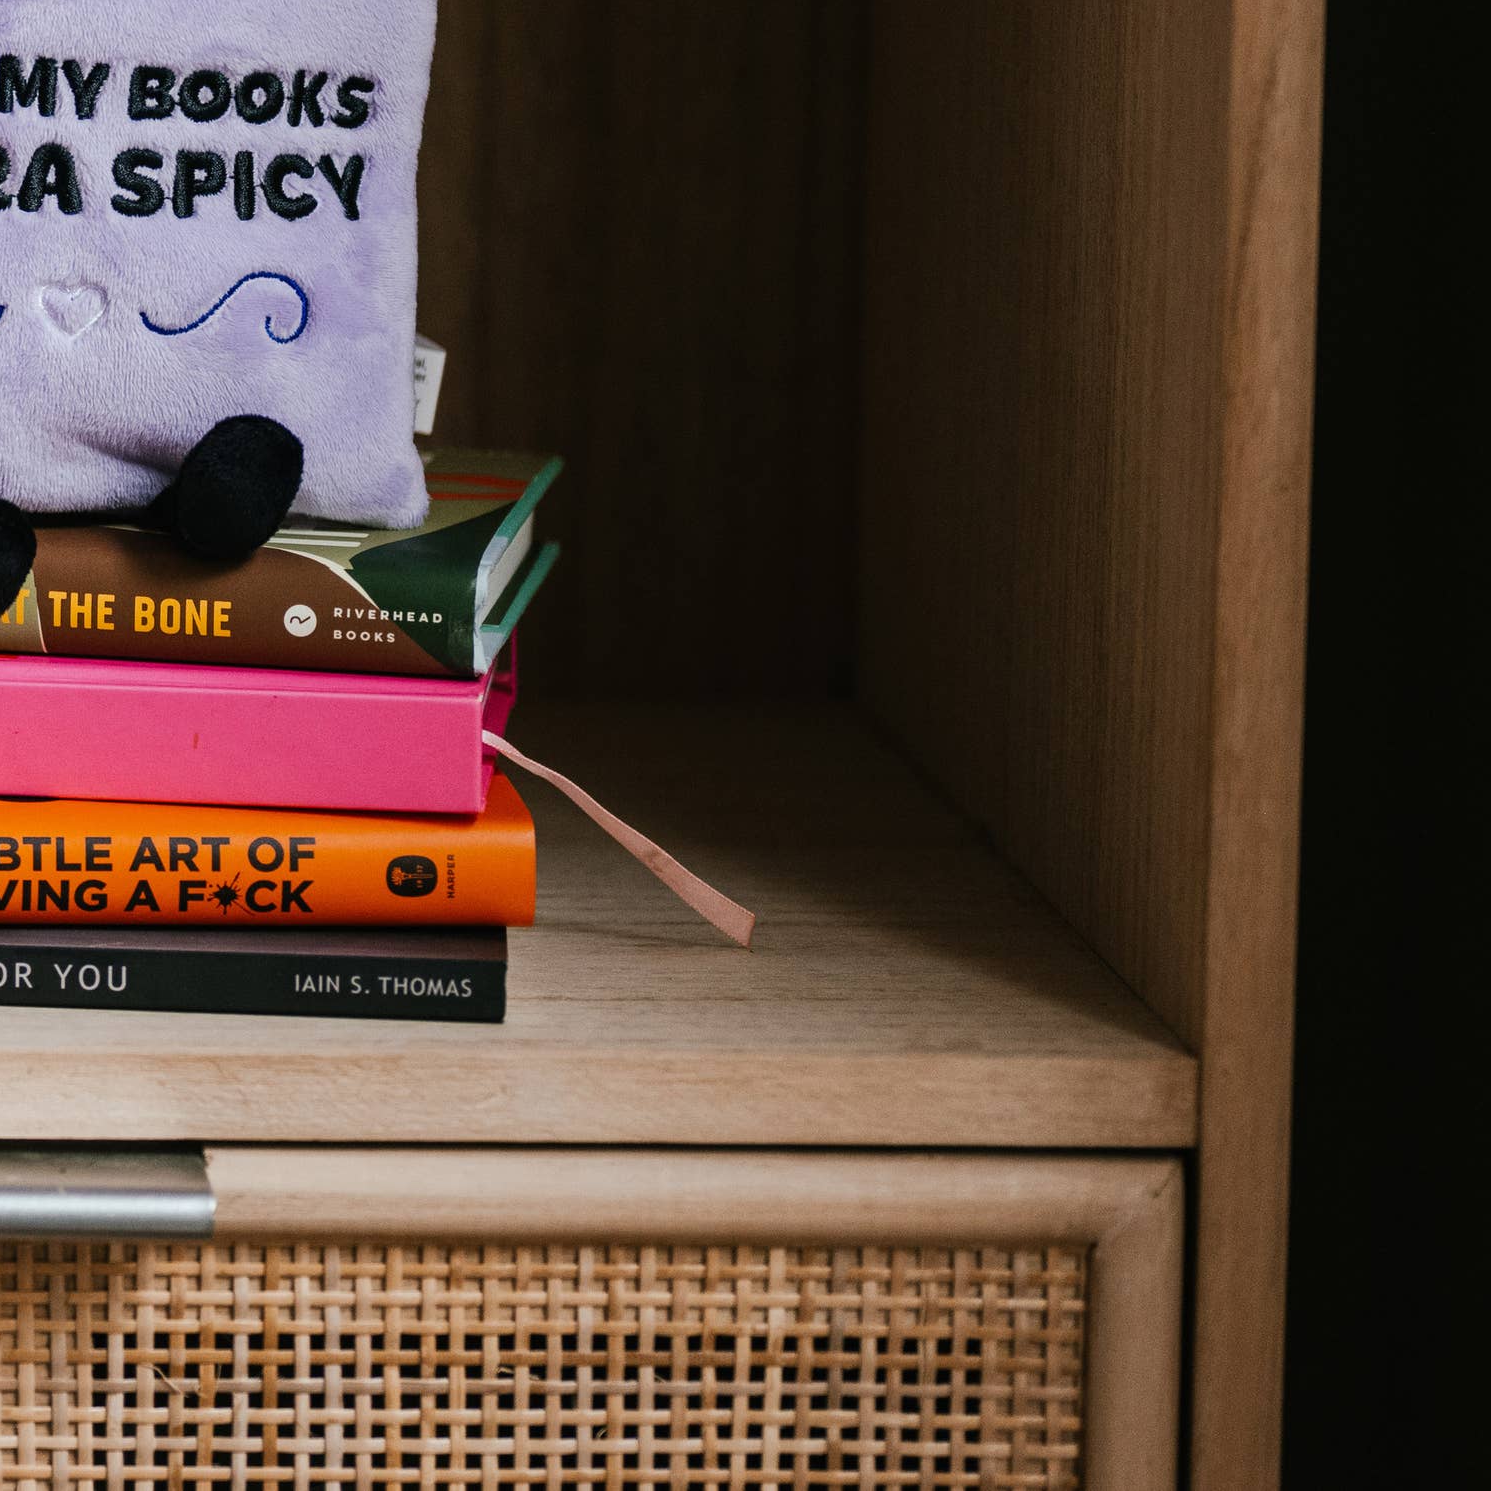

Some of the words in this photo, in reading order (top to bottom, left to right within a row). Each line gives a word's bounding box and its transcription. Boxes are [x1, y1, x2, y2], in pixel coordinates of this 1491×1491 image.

[127, 65, 375, 129] BOOKS
[110, 147, 366, 222] SPICY
[47, 590, 116, 631] THE
[133, 595, 233, 638] BONE
[333, 607, 443, 624] RIVERHEAD
[333, 629, 396, 644] BOOKS
[129, 836, 231, 873] ART
[246, 836, 317, 873] OF
[446, 854, 456, 900] HARPER
[124, 879, 161, 912] A
[53, 963, 128, 992] YOU
[294, 973, 342, 994] IAIN
[349, 974, 371, 996] S.
[378, 975, 474, 999] THOMAS
